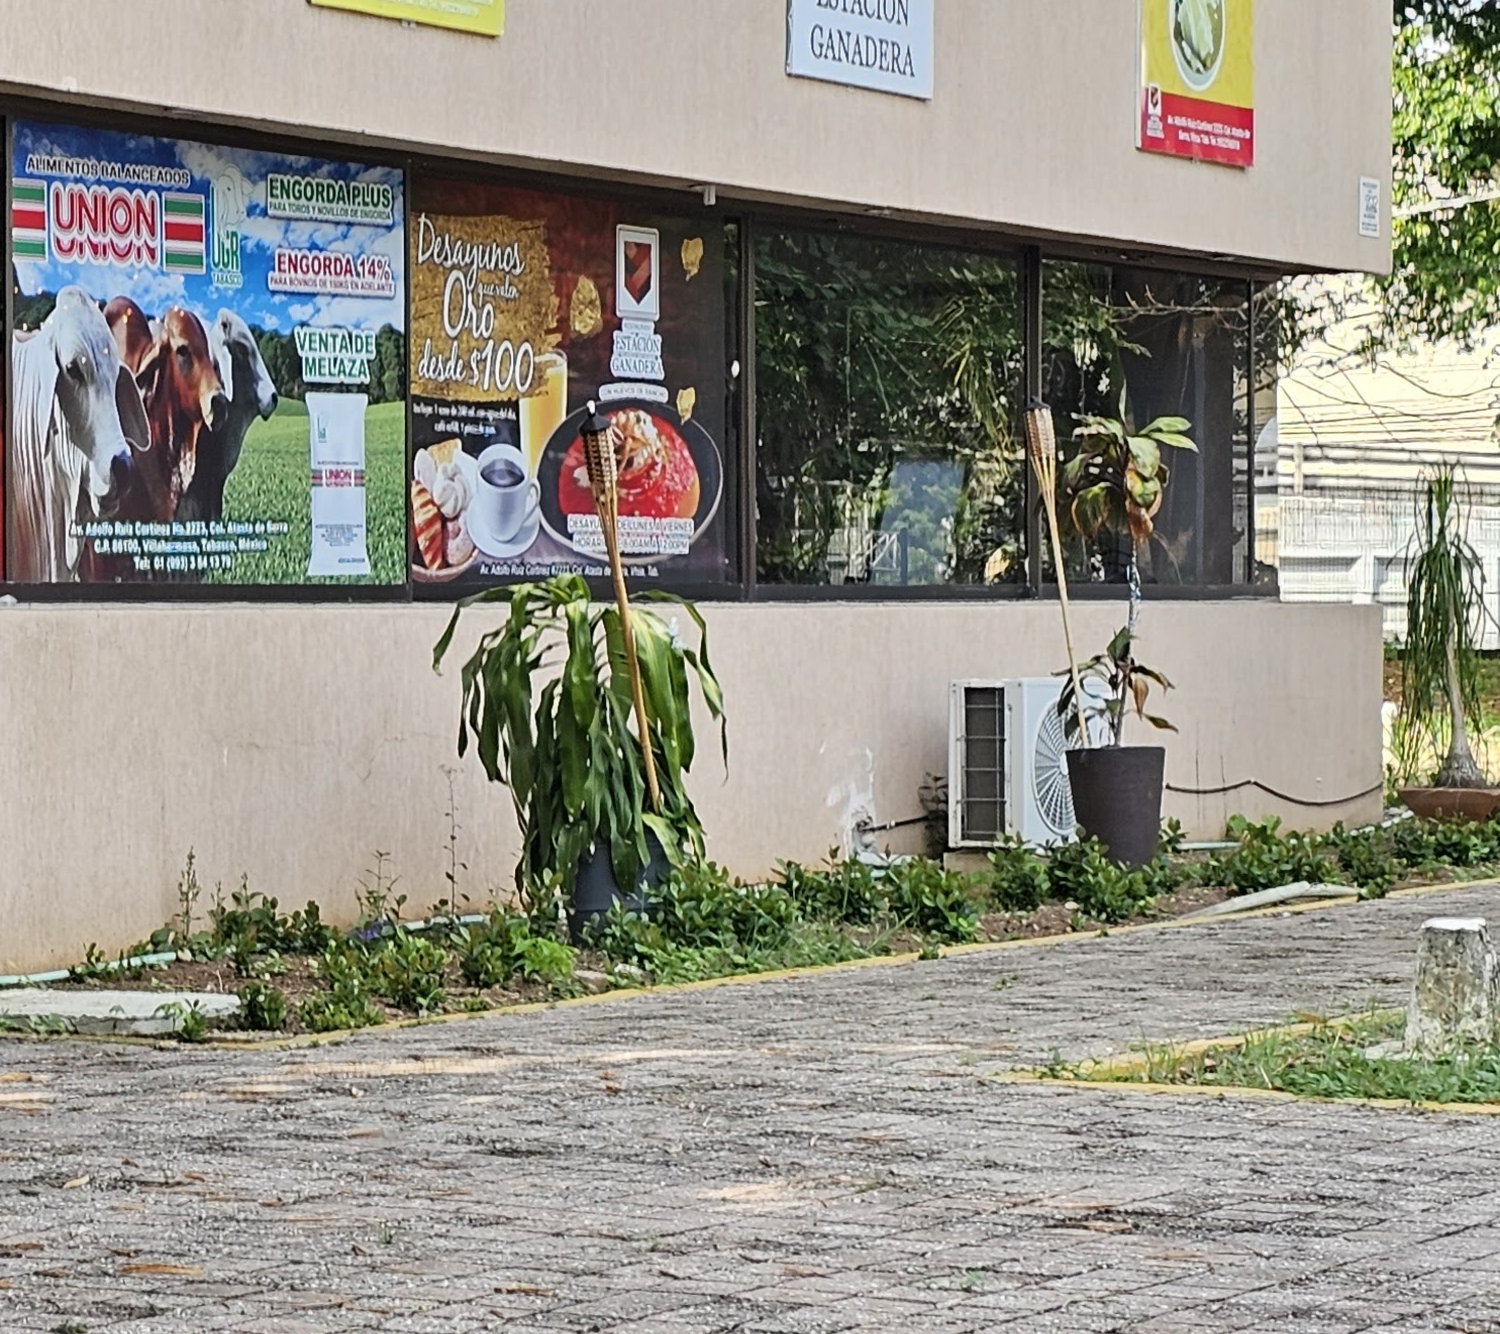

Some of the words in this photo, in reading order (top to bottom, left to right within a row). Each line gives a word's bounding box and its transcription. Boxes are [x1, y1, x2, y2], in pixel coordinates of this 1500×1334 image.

[810, 24, 915, 77] GANADERA
[27, 157, 99, 176] ALIMENTOS
[101, 162, 189, 185] BALANCEADOS
[269, 178, 347, 205] ENGORDA
[351, 184, 391, 208] PLUS
[53, 187, 157, 242] UNION
[269, 201, 287, 212] PARA
[288, 203, 311, 214] TOROS
[311, 204, 317, 215] Y
[318, 205, 349, 218] NOVILLOS
[350, 208, 359, 219] DE
[417, 212, 526, 291] Desayunos
[212, 273, 242, 286] TABASCO
[277, 253, 356, 278] ENGORDA
[358, 258, 390, 281] 14%
[270, 276, 287, 286] PARA
[319, 279, 327, 289] DE
[350, 280, 359, 290] EN
[360, 281, 393, 293] ADELANTE
[443, 269, 495, 339] Oro
[296, 330, 350, 354] VENTA
[354, 334, 374, 355] DE
[615, 335, 660, 353] ESTACIÓN
[304, 356, 368, 378] MELAZA
[418, 338, 467, 383] desde
[468, 339, 534, 394] $100
[611, 357, 663, 375] GANADERA
[324, 469, 352, 481] UNION
